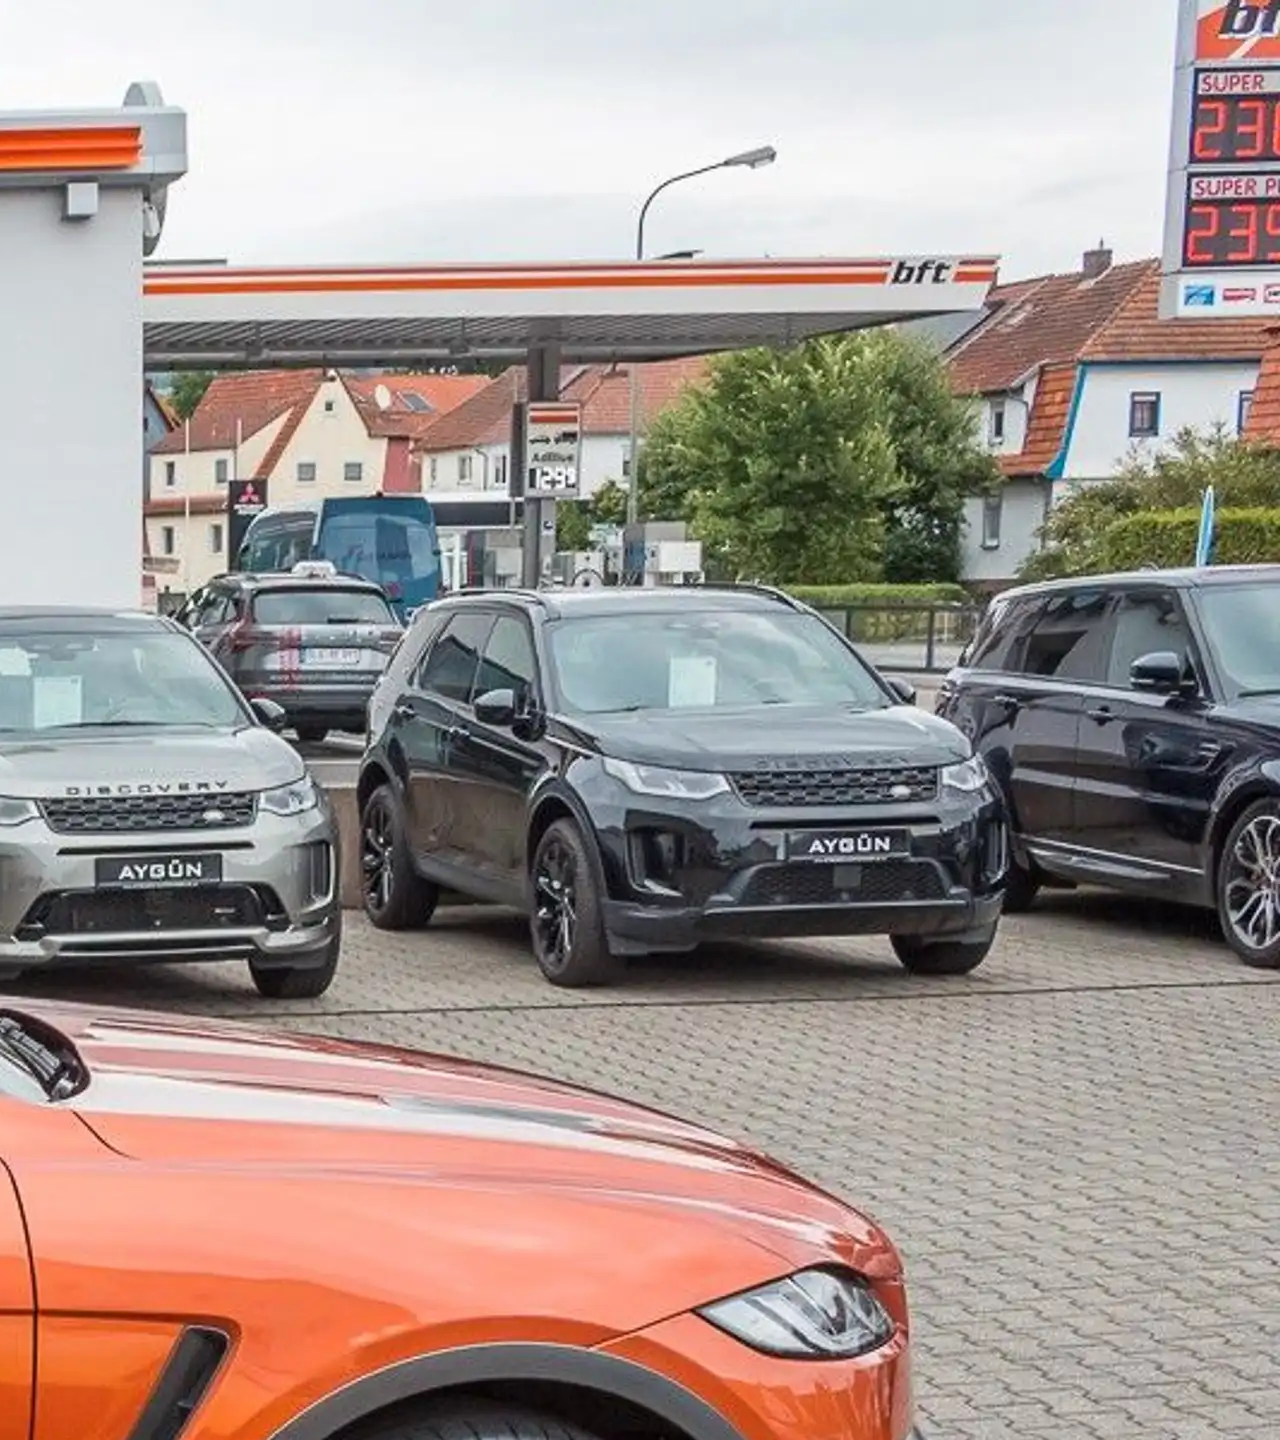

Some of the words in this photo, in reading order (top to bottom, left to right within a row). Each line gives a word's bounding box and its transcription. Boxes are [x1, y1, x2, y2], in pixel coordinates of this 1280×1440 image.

[1201, 74, 1265, 93] SUPER
[1194, 100, 1280, 158] 23
[1193, 178, 1257, 197] SUPER
[1265, 177, 1280, 195] P
[891, 260, 952, 284] bft
[65, 780, 229, 796] DISCOVERY
[808, 833, 891, 854] AYGÜN
[117, 859, 203, 881] AYGÜN
